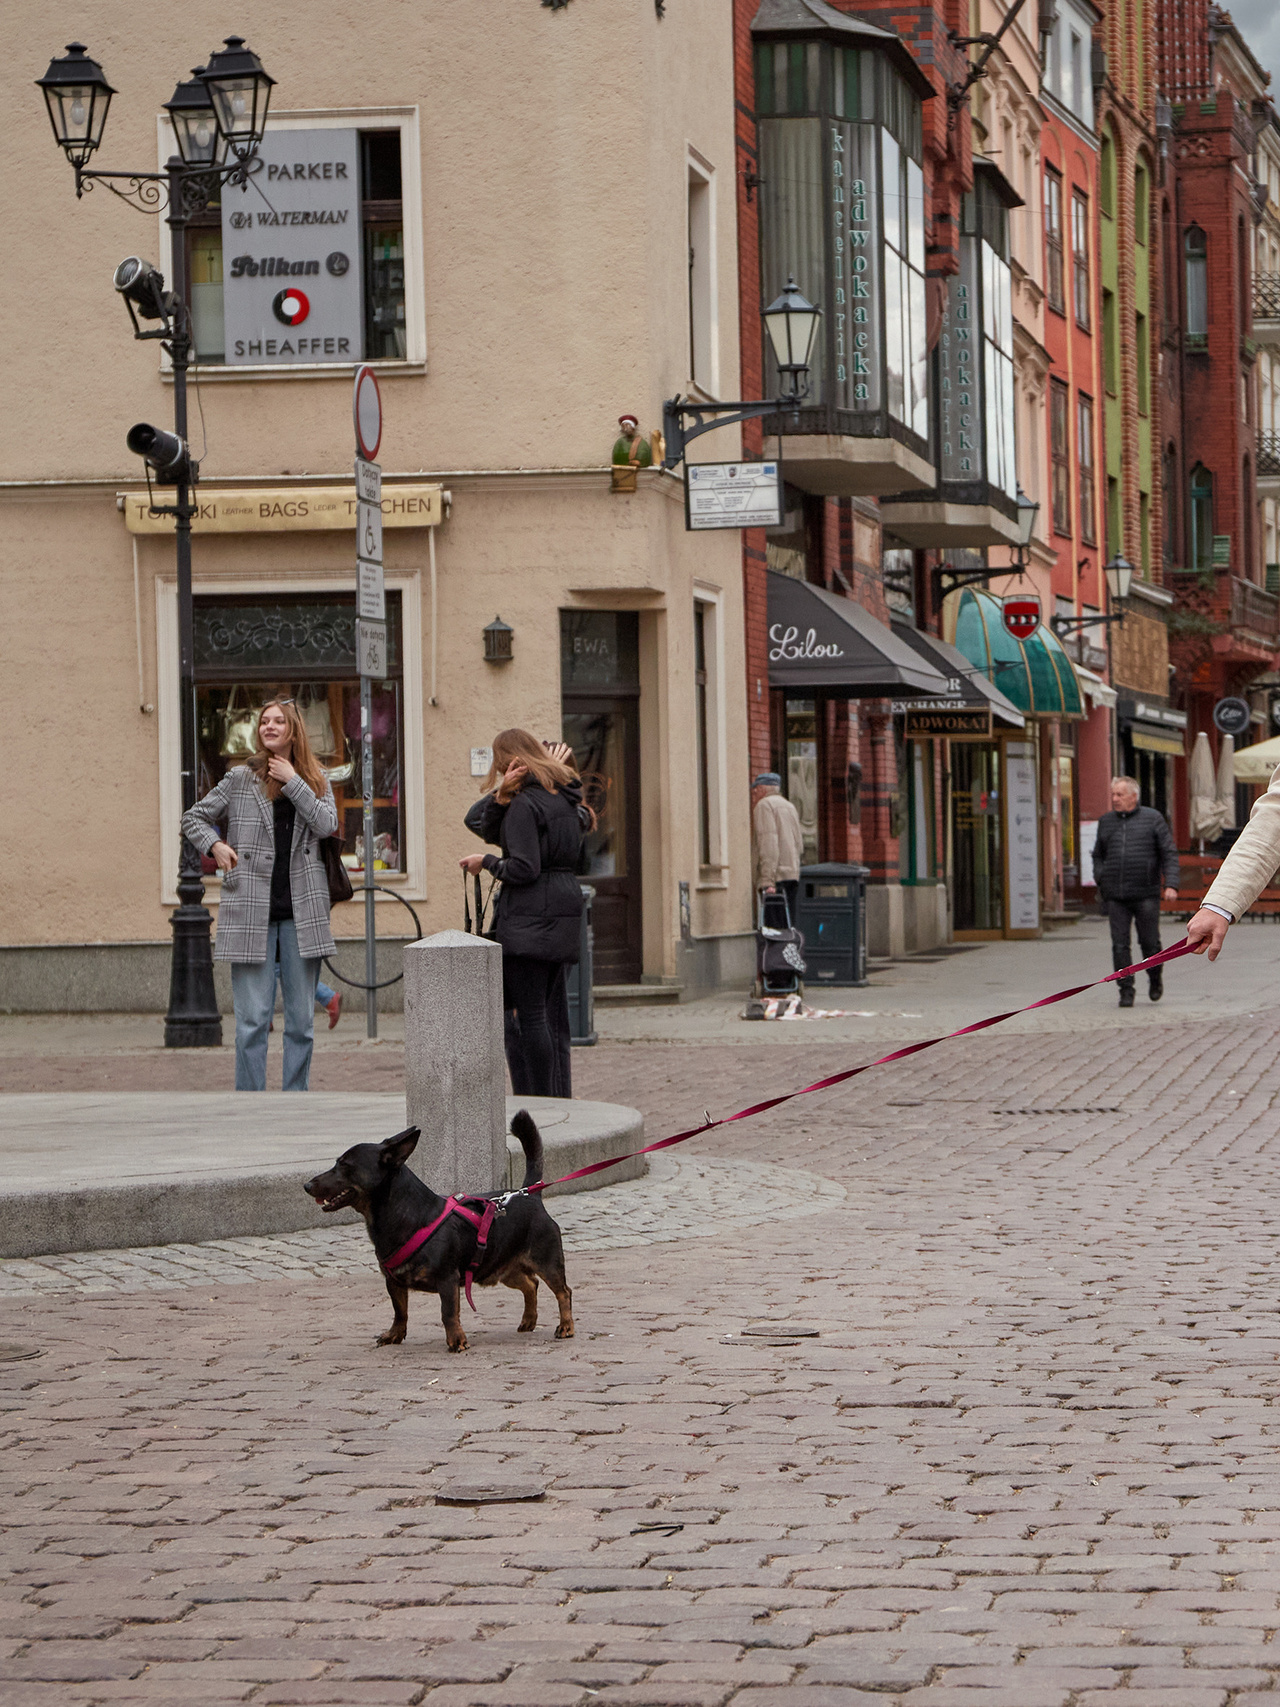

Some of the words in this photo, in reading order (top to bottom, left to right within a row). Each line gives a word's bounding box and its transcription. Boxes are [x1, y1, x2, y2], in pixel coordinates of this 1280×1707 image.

[267, 162, 348, 181] PARKER
[257, 209, 348, 226] WATERMAN
[831, 128, 846, 382] kancelaria
[230, 255, 320, 278] Pelikan
[850, 179, 870, 401] adwokacka
[234, 337, 350, 356] SHEAFFER
[954, 283, 974, 471] adwokacka
[221, 506, 254, 516] LEATHER
[258, 501, 309, 518] BAGS
[313, 504, 337, 512] LEDER
[343, 498, 431, 515] TCHEN
[360, 626, 369, 639] Nie
[769, 623, 844, 661] Lilou
[574, 637, 609, 653] EWA
[909, 716, 987, 729] ADWOKAT
